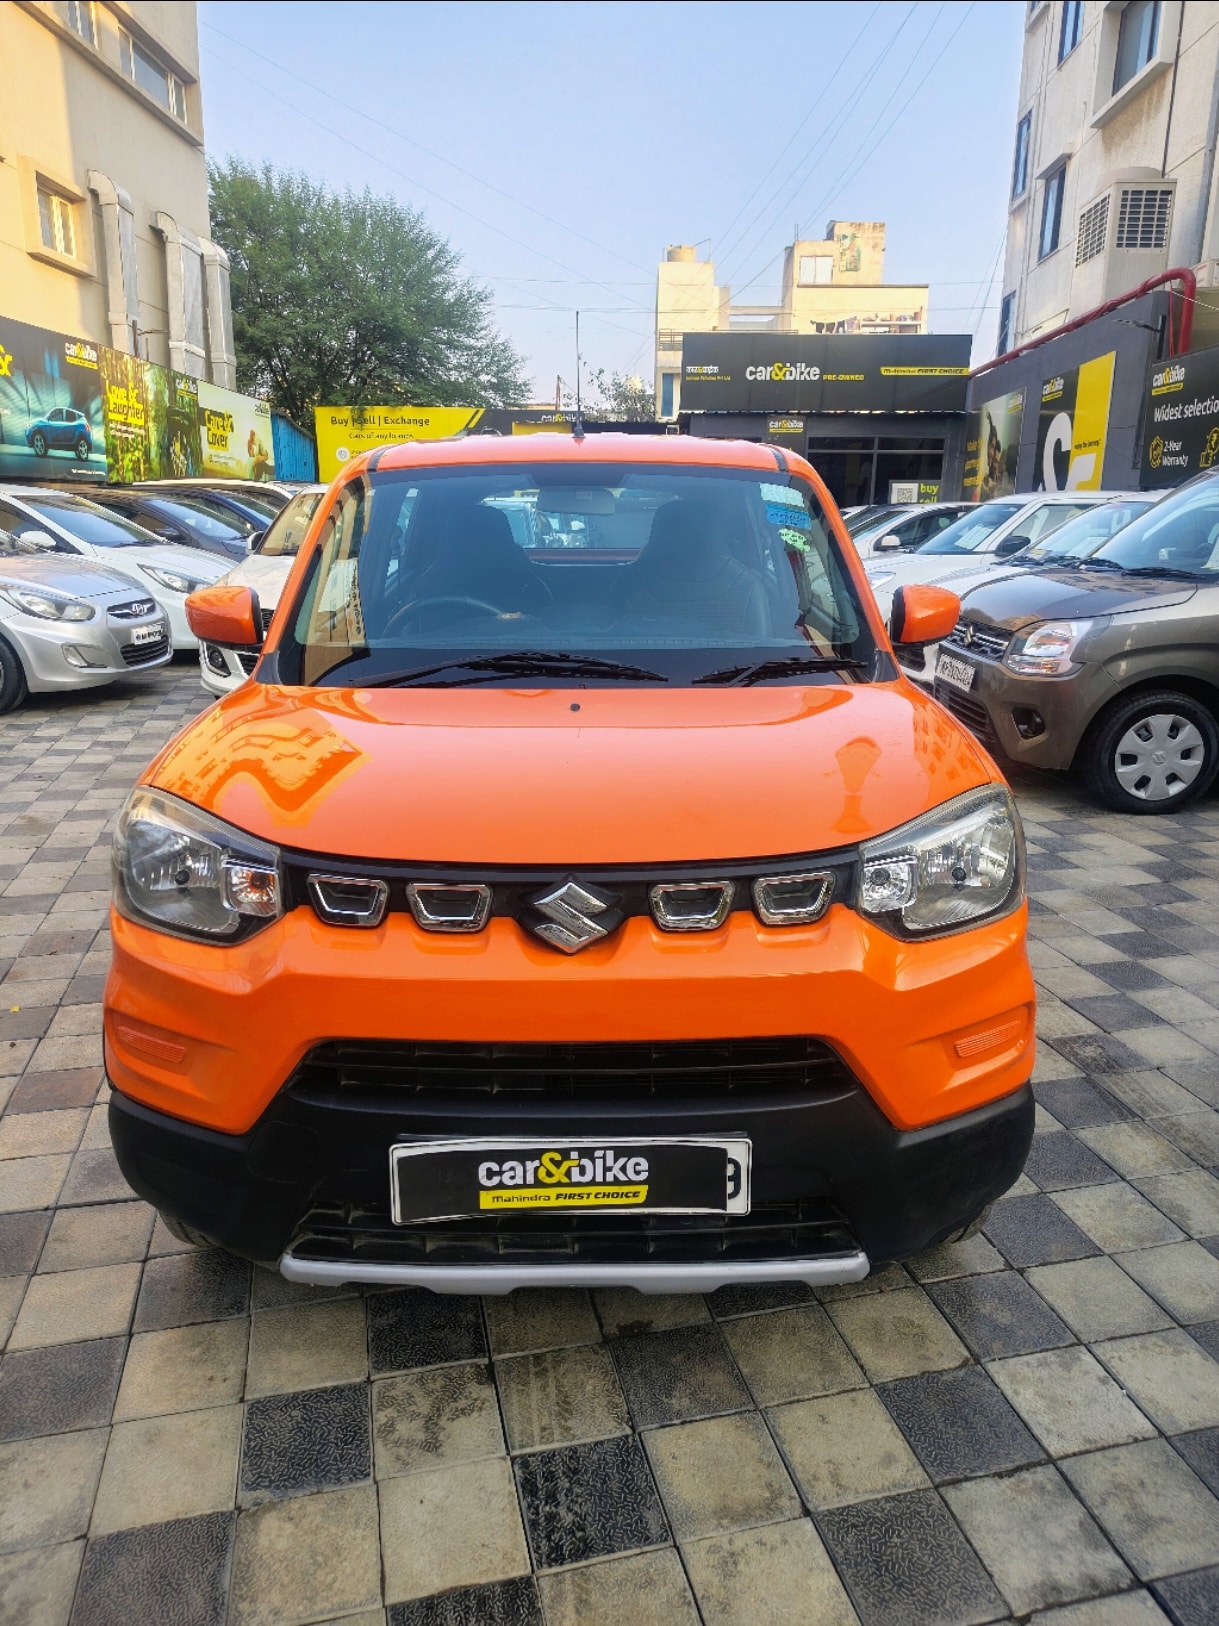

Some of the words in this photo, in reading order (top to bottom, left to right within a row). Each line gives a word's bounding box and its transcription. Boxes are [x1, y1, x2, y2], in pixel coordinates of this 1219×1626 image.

[745, 361, 821, 381] car&bike
[1153, 365, 1185, 387] car&bike
[106, 379, 127, 402] Love
[109, 400, 144, 420] Laughter
[1154, 403, 1183, 422] Widest
[331, 416, 349, 427] Buy
[384, 416, 430, 427] Exchange
[769, 419, 804, 429] car&bike
[207, 428, 228, 448] Cover
[1164, 440, 1182, 452] 2-Year
[1162, 454, 1189, 467] Warranty
[920, 483, 939, 494] buy
[478, 1150, 649, 1187] car&bike
[492, 1194, 551, 1204] Mahindra
[555, 1192, 590, 1201] FIRST
[594, 1191, 641, 1200] CHOICE
